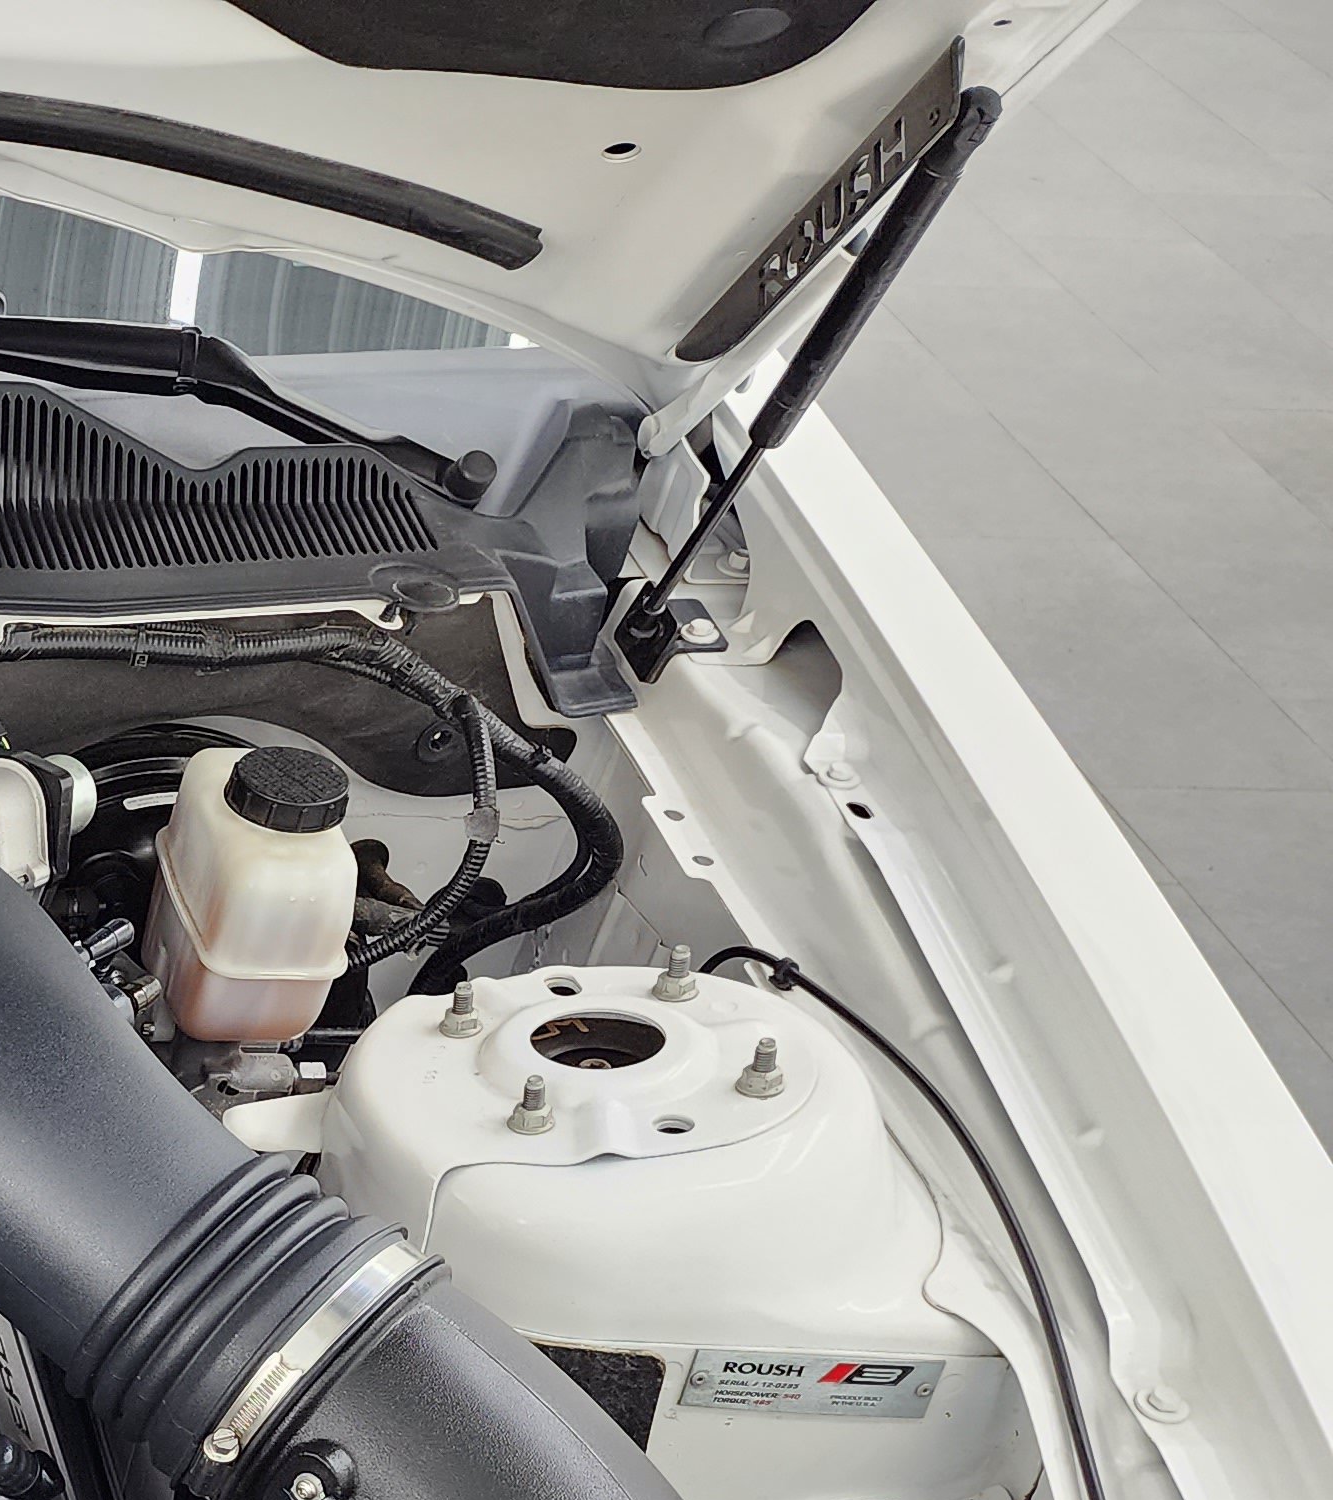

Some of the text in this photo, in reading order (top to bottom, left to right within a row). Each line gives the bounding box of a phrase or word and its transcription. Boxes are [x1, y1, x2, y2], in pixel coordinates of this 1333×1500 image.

[759, 115, 906, 308] ROUSH
[723, 1361, 806, 1377] ROUSH
[718, 1379, 751, 1387] SERIAL
